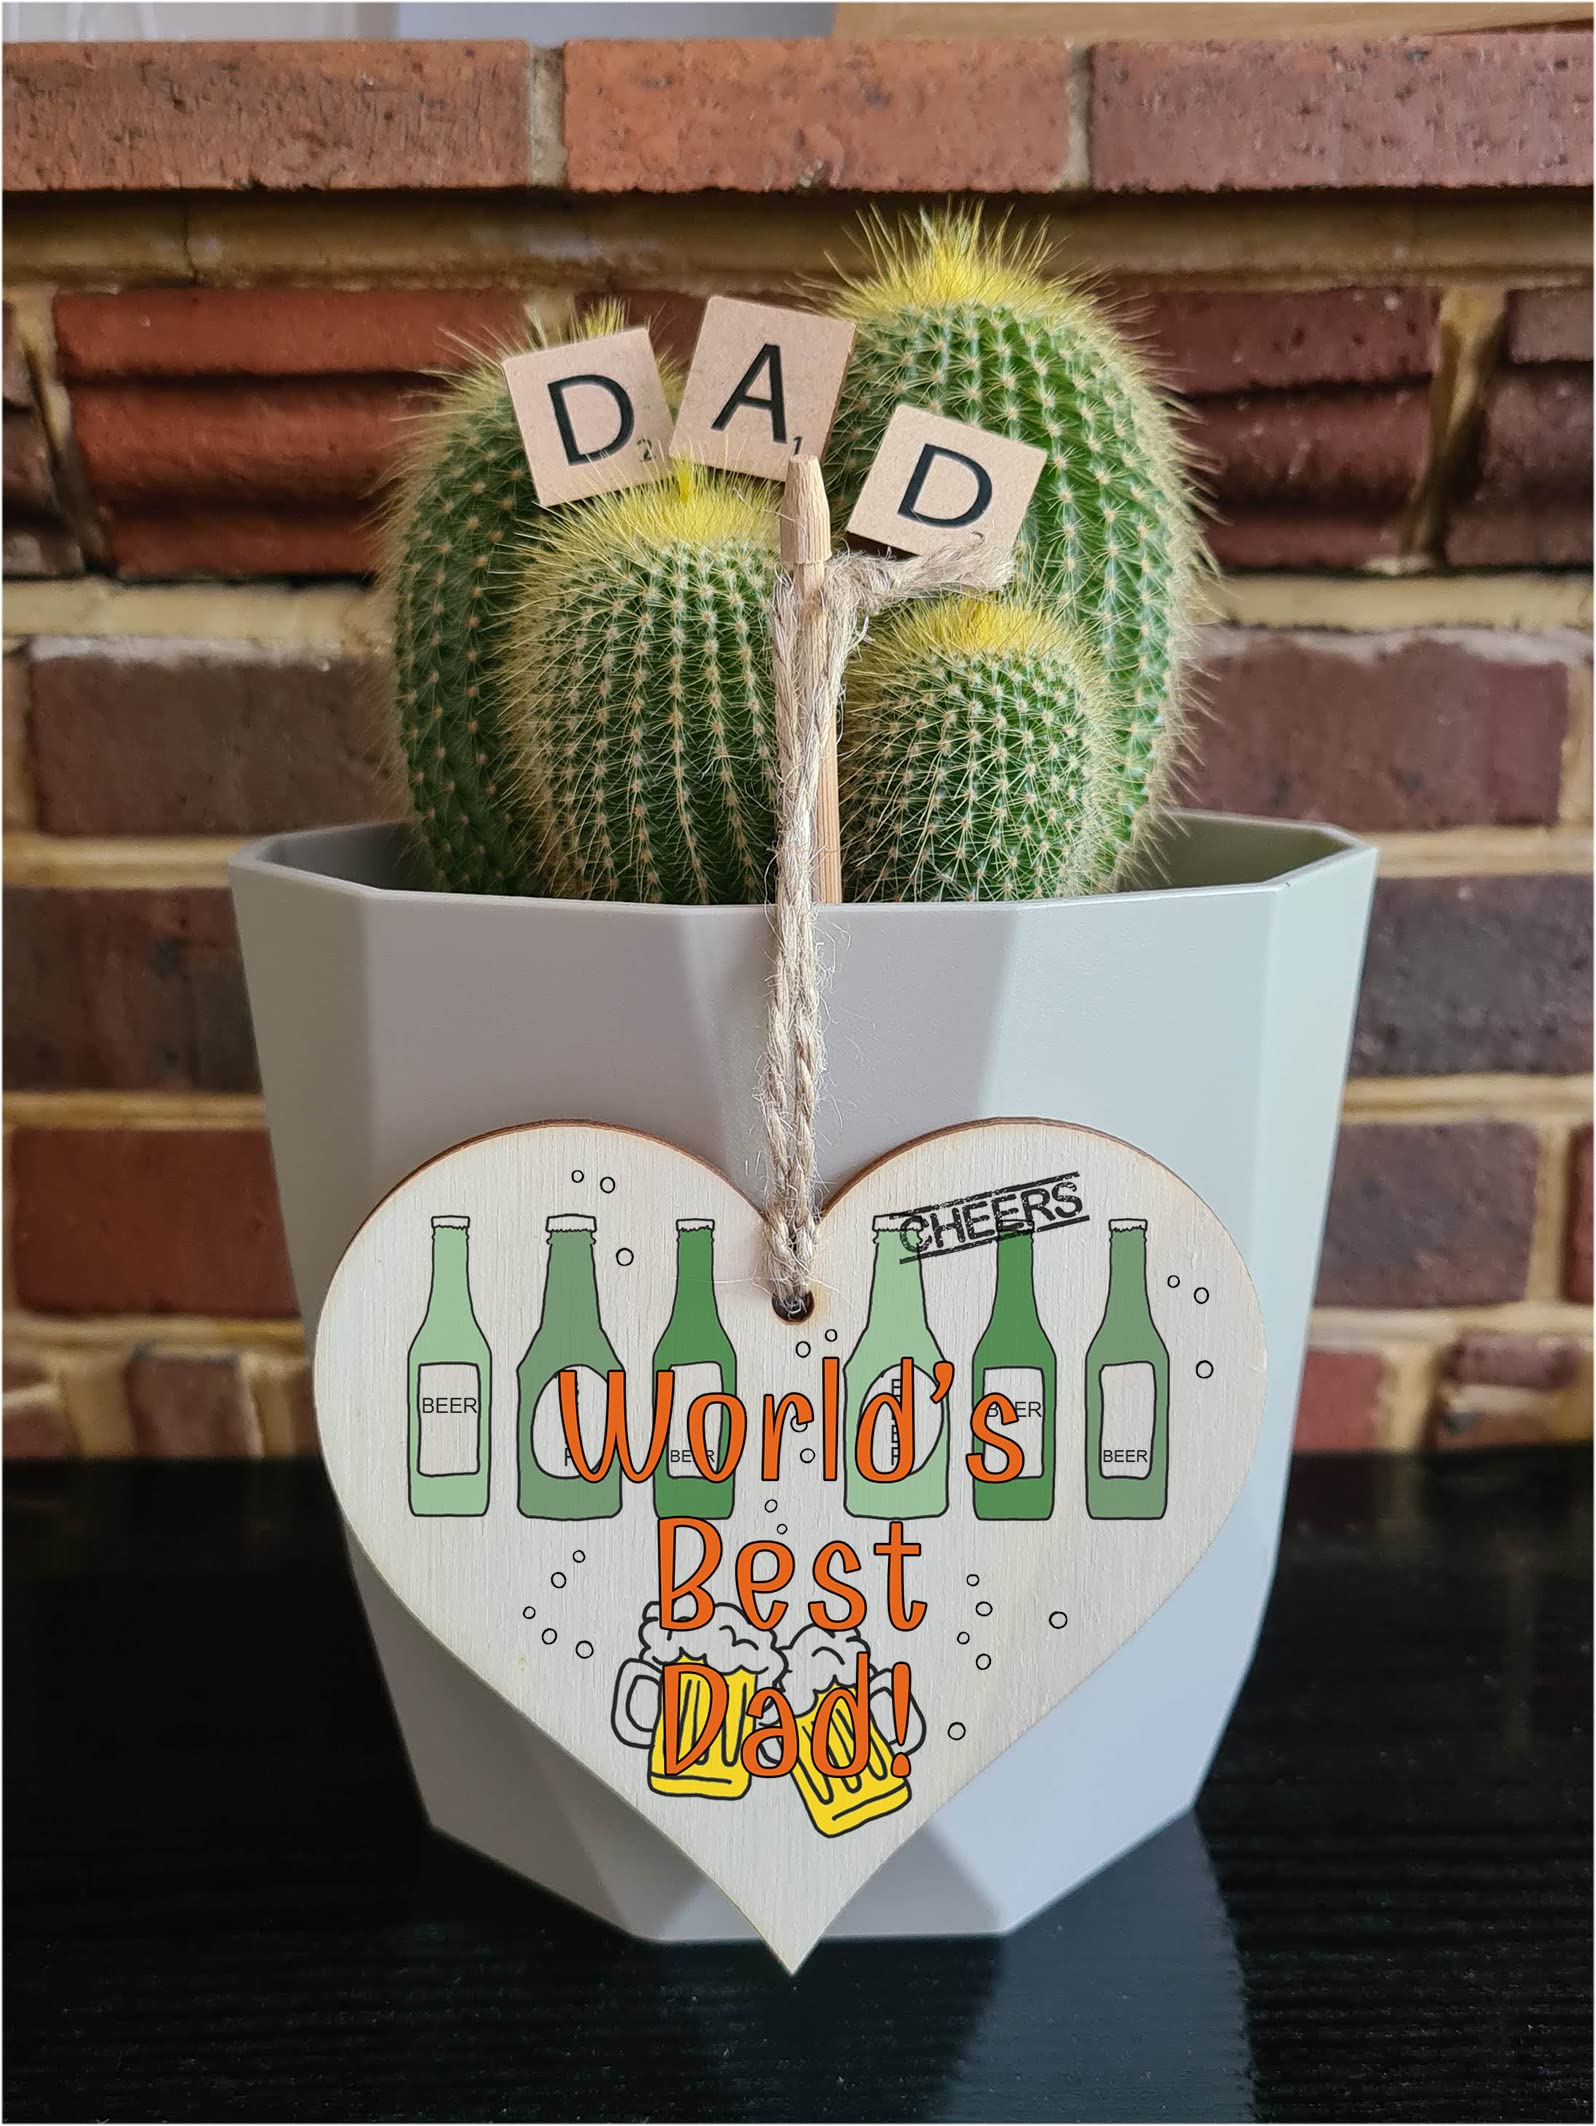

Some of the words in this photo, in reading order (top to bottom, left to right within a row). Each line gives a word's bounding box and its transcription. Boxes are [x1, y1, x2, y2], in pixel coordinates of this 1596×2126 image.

[900, 1180, 1084, 1254] CHEERS
[421, 1397, 478, 1414] BEER
[558, 1356, 1026, 1484] World's
[986, 1401, 1042, 1418] BER
[671, 1449, 716, 1463] BER
[1102, 1449, 1148, 1463] BEER
[657, 1516, 928, 1632] Best
[662, 1651, 912, 1778] Dad!
